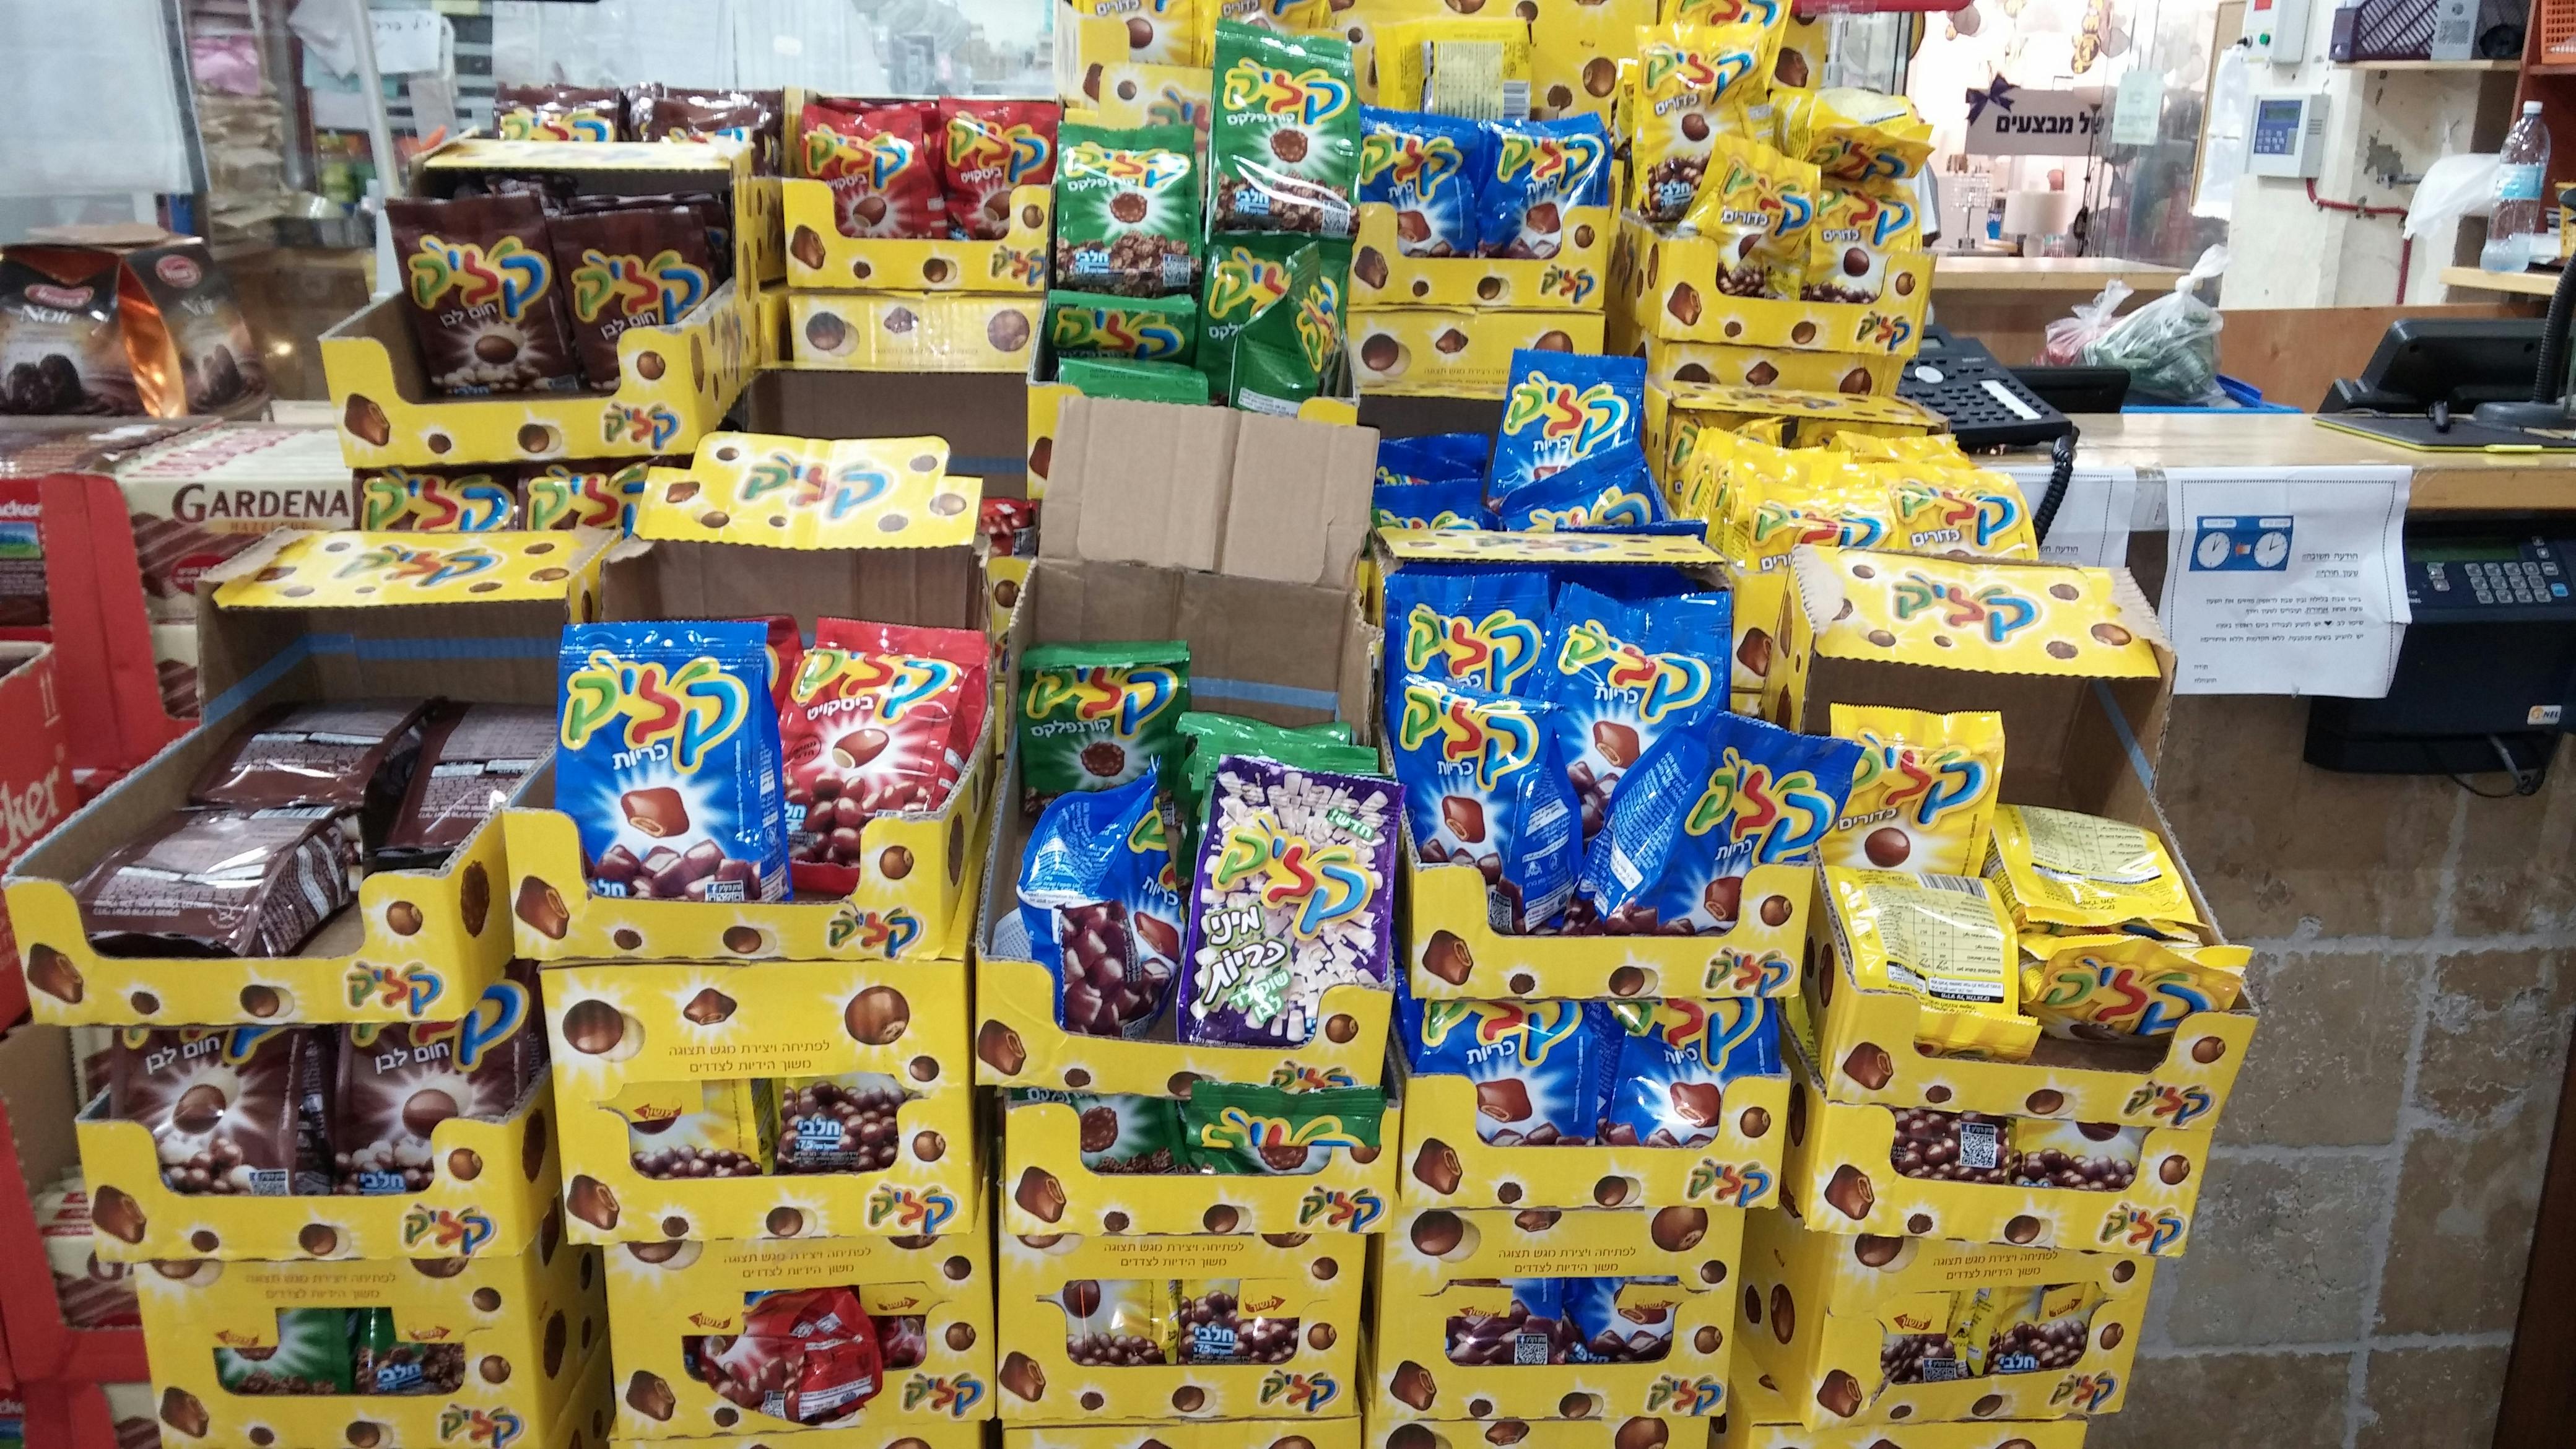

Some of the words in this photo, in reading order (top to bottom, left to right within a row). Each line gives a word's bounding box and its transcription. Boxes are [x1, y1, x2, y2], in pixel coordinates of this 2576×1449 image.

[1642, 44, 1756, 105] קליק
[1224, 58, 1351, 126] קליק
[1655, 94, 1699, 116] כדורים
[1227, 113, 1294, 125] קורנפלקס
[1996, 115, 2073, 134] מבצעים
[805, 123, 913, 189] קליק
[947, 112, 1050, 183] קליק
[1063, 141, 1190, 190] קליק
[1362, 126, 1463, 201] קליק
[1497, 132, 1604, 193] קליק
[960, 168, 1002, 182] ביסקויט
[1526, 176, 1557, 194] כריות
[1235, 188, 1269, 204] חלבי
[1723, 210, 1769, 226] כדורים
[1818, 187, 1915, 246] קליק
[1822, 228, 1860, 243] כדורים
[991, 246, 1046, 286] קליק
[1076, 250, 1108, 263] חלבי
[406, 234, 551, 322] קליק
[572, 249, 708, 323] קליק
[1541, 264, 1596, 303] קליק
[20, 304, 71, 324] Noir
[440, 308, 464, 329] לבן
[469, 303, 497, 321] חום
[626, 313, 656, 327] חום
[601, 315, 622, 340] לבן
[1056, 308, 1184, 360] קליק
[1858, 311, 1912, 351] קליק
[1503, 370, 1629, 458] קליק
[604, 402, 680, 450] קליק
[1533, 437, 1571, 453] כריות
[743, 452, 890, 519] קליק
[172, 482, 349, 524] GARDENA
[361, 469, 514, 531] קליק
[1897, 479, 2023, 548] קליק
[1911, 530, 1961, 547] כדורים
[335, 545, 503, 587] קליק
[1892, 570, 2041, 643] קליק
[1406, 604, 1542, 694] קליק
[1559, 619, 1711, 723] קליק
[790, 649, 958, 724] קליק
[1595, 687, 1638, 703] כריות
[562, 649, 749, 773] קליק
[806, 697, 874, 721] ביסקויט
[1026, 666, 1178, 739] קליק
[1032, 719, 1111, 737] קורנפלקס
[1400, 684, 1539, 791] קליק
[613, 747, 669, 771] כריות
[1437, 759, 1474, 777] כריות
[1685, 747, 1834, 863] קליק
[1329, 809, 1375, 840] חדש!
[1838, 807, 1898, 830] כדורים
[1715, 840, 1752, 861] כריות
[1212, 812, 1373, 939] קליק
[829, 905, 922, 959] קליק
[1208, 906, 1261, 941] מיני
[1204, 941, 1286, 1003] כריות
[1705, 947, 1793, 997] קליק
[347, 960, 443, 1017] קליק
[1230, 971, 1290, 1004] שוקולד
[2039, 955, 2213, 1037] קליק
[1255, 998, 1283, 1022] לבן
[184, 1038, 219, 1060] חום
[416, 1042, 449, 1063] חום
[669, 1045, 705, 1056] תצוגה
[710, 1045, 736, 1055] מגש
[741, 1043, 777, 1053] ויצירת
[782, 1040, 830, 1052] לפתיחה
[1467, 1041, 1515, 1065] כריות
[146, 1048, 178, 1074] לבן
[375, 1048, 408, 1074] לבן
[690, 1060, 733, 1073] לצדדים
[739, 1061, 775, 1071] הידיות
[781, 1060, 811, 1072] משוך
[643, 1107, 674, 1120] משוך
[2123, 1081, 2216, 1126] קליק
[797, 1118, 840, 1136] חלבי
[360, 1170, 404, 1188] חלבי
[1687, 1158, 1772, 1207] קליק
[866, 1183, 957, 1234] קליק
[1299, 1186, 1385, 1232] קליק
[402, 1203, 494, 1256] קליק
[2099, 1203, 2186, 1253] קליק
[790, 1250, 823, 1260] ויצירת
[827, 1247, 871, 1258] לפתיחה
[1104, 1243, 1135, 1251] תצוגה
[1140, 1243, 1162, 1251] מגש
[1167, 1243, 1198, 1251] ויצירת
[1203, 1242, 1244, 1251] לפתיחה
[1499, 1250, 1530, 1258] תצוגה
[1534, 1249, 1556, 1258] מגש
[1560, 1248, 1591, 1258] ויצירת
[1595, 1246, 1636, 1257] לפתיחה
[2020, 1251, 2058, 1261] לפתיחה
[724, 1253, 757, 1263] תצוגה
[762, 1253, 785, 1263] מגש
[1121, 1256, 1159, 1266] לצדדים
[1163, 1258, 1195, 1266] הידיות
[1201, 1258, 1227, 1268] משוך
[1515, 1262, 1551, 1273] לצדדים
[1556, 1264, 1587, 1272] הידיות
[1594, 1263, 1619, 1273] משוך
[1933, 1257, 1962, 1266] תצוגה
[1965, 1256, 1985, 1265] מגש
[1989, 1254, 2016, 1263] ויצירת
[742, 1266, 782, 1278] לצדדים
[788, 1266, 821, 1276] הידיות
[829, 1264, 855, 1275] משוך
[1947, 1268, 1980, 1279] לצדדים
[1983, 1268, 2012, 1277] הידיות
[2017, 1267, 2040, 1278] משוך
[1250, 1299, 1277, 1312] משוך
[697, 1316, 724, 1329] משוך
[1902, 1316, 1925, 1328] משוך
[1194, 1326, 1234, 1342] חלבי
[1998, 1352, 2035, 1369] חלבי
[902, 1372, 986, 1419] קליק
[1260, 1370, 1338, 1412] קליק
[1646, 1373, 1723, 1417] קליק
[2049, 1370, 2119, 1408] קליק
[438, 1404, 524, 1449] קליק
